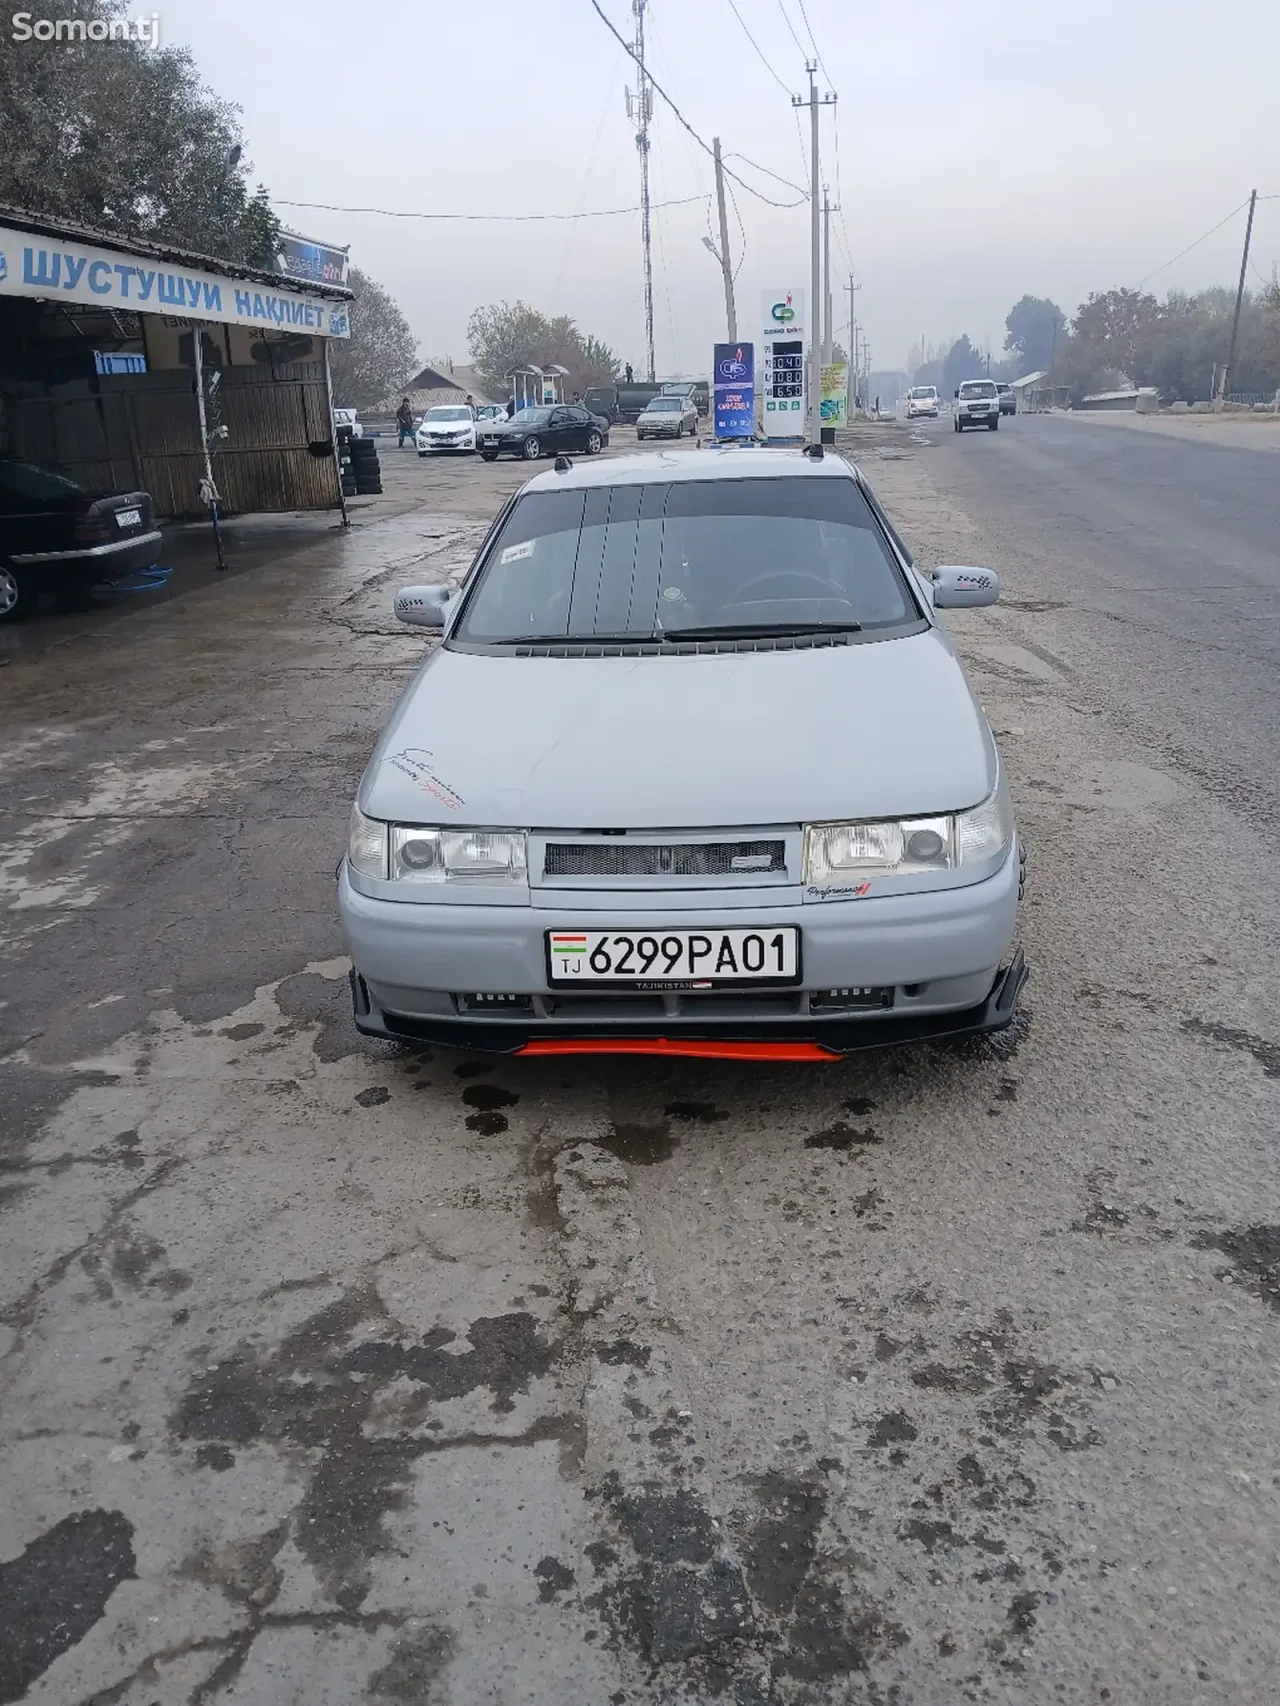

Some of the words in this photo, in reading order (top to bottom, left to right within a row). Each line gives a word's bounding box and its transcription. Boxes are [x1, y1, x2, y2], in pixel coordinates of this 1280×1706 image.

[561, 959, 581, 973] TJ
[589, 934, 784, 974] 6299PA01
[636, 982, 693, 990] TAJIKISTAN
